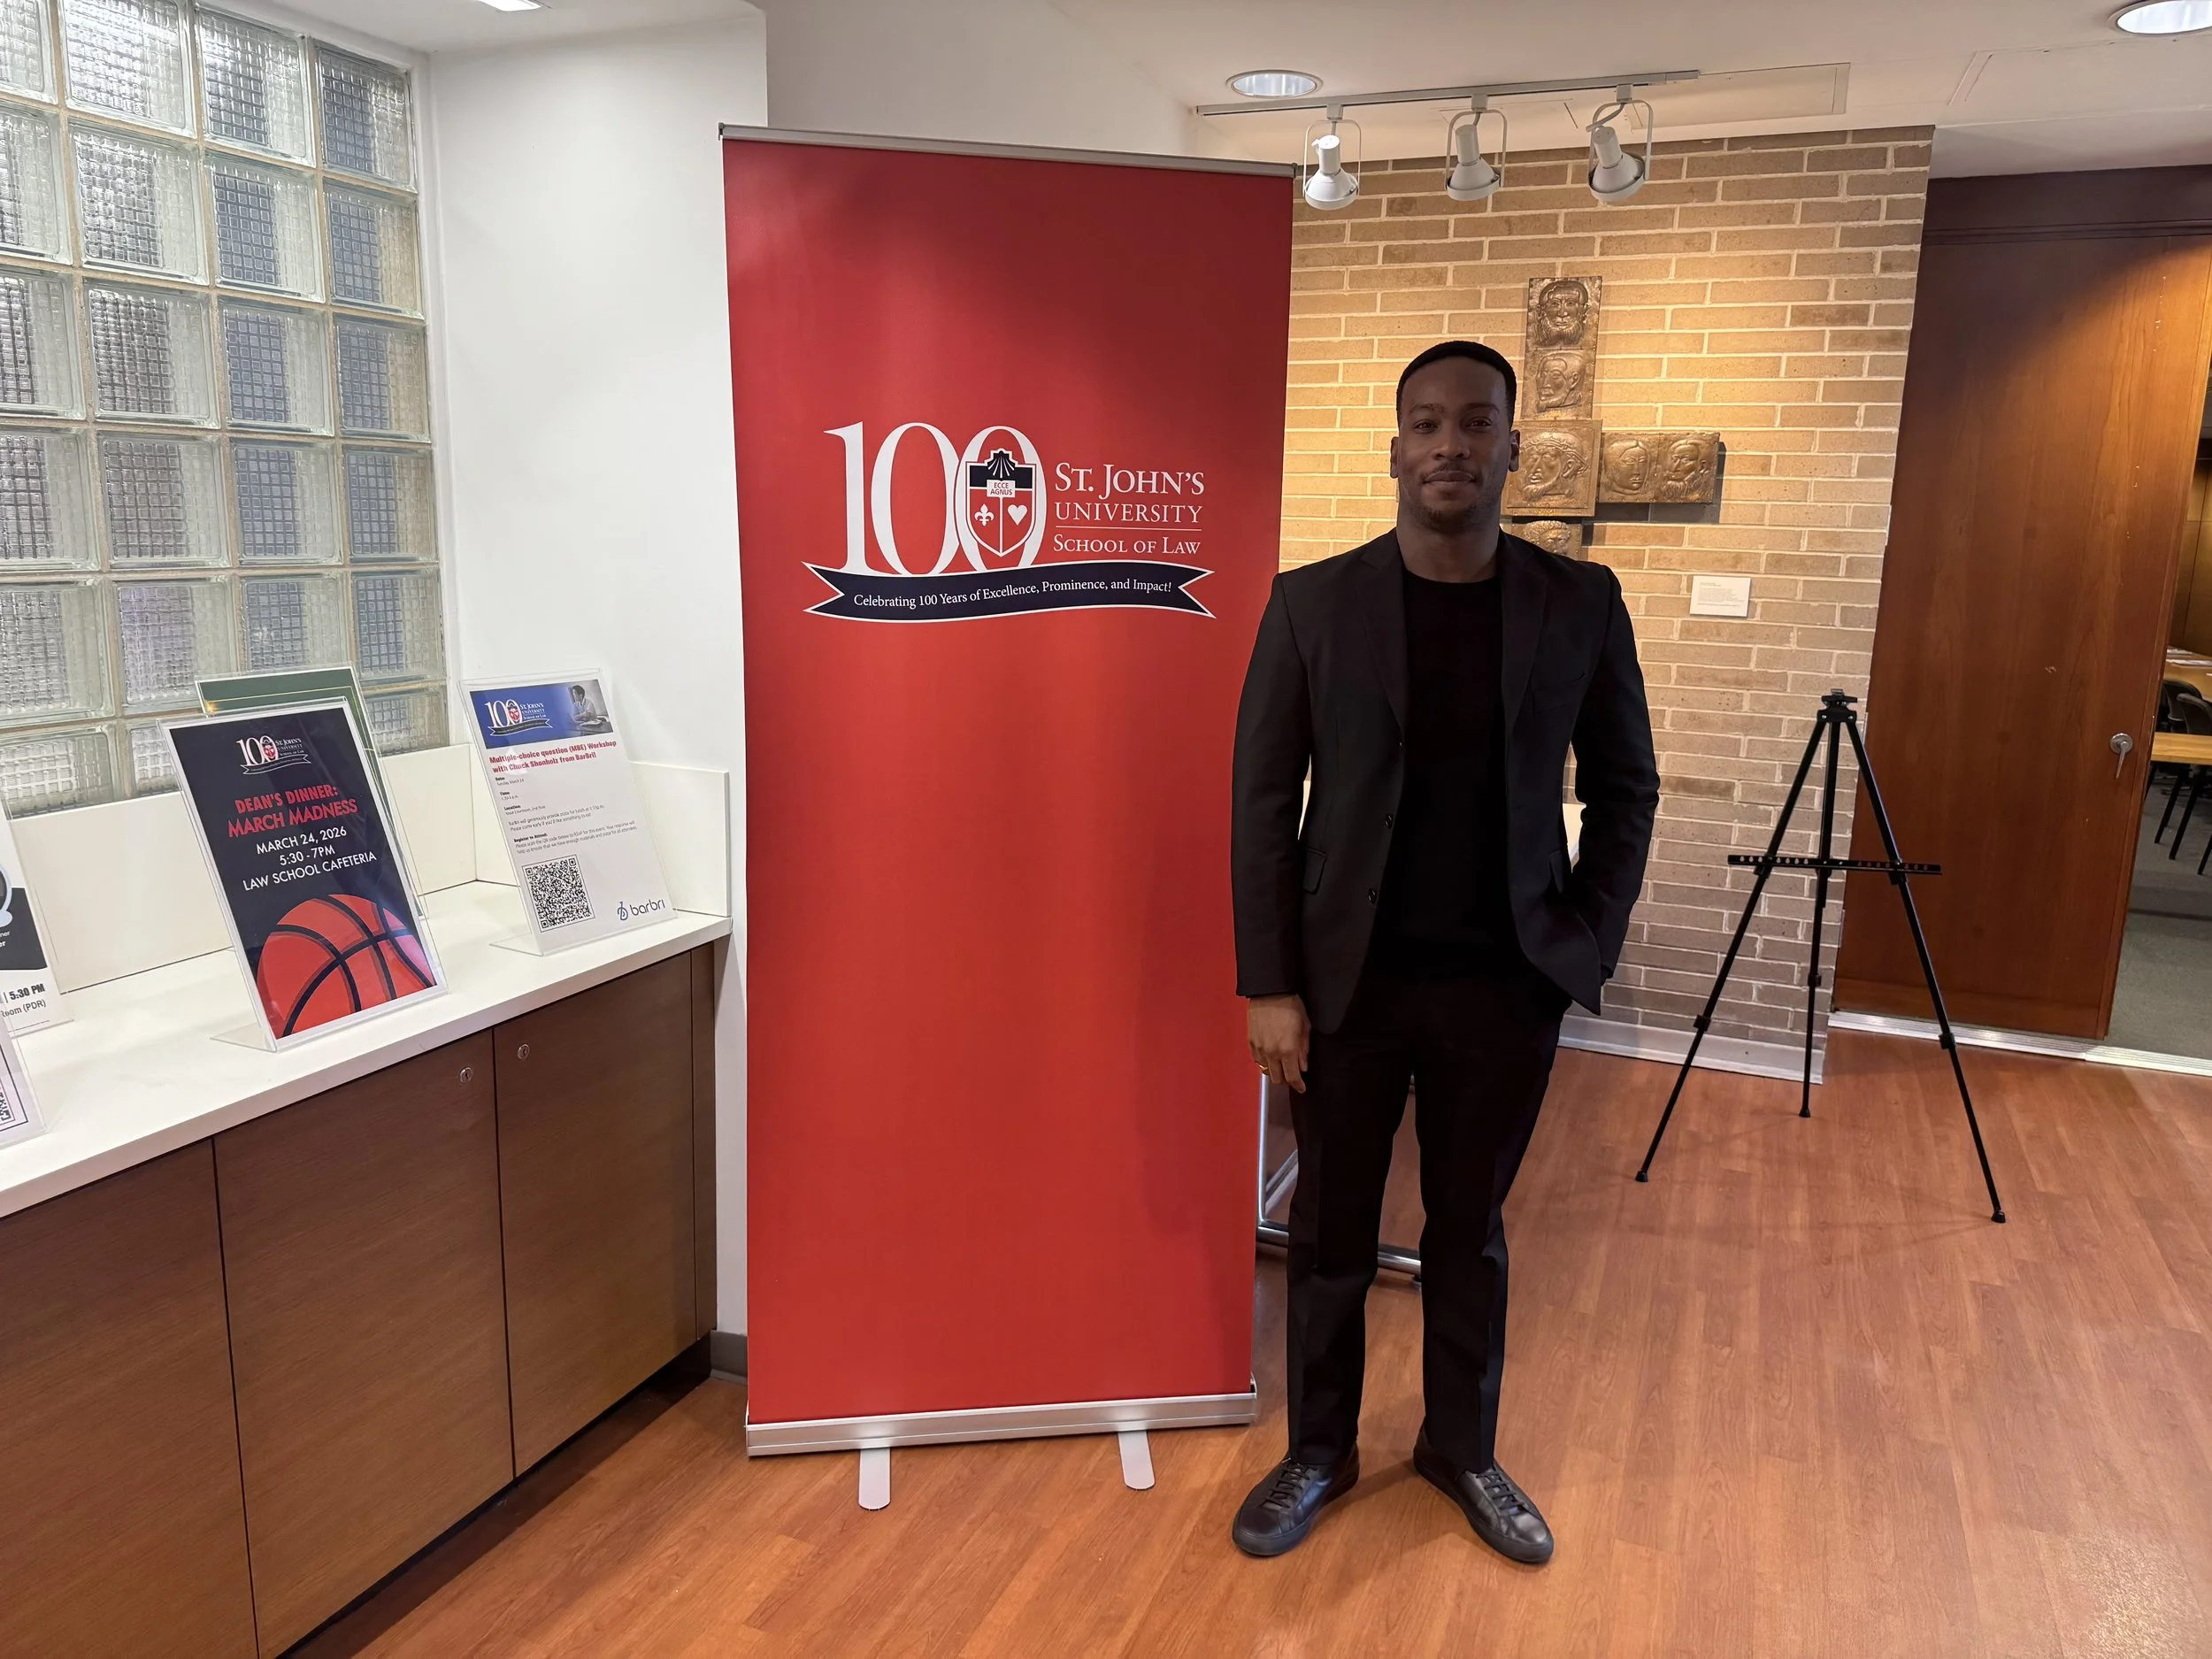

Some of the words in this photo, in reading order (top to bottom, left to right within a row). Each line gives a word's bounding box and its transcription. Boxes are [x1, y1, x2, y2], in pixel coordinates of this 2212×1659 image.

[823, 421, 1047, 576] 100
[1055, 502, 1203, 523] UNIVERSITY
[853, 594, 917, 610] Celebrating
[919, 595, 938, 606] 100
[940, 593, 968, 604] Years
[971, 588, 982, 601] of
[983, 583, 1040, 600] Excellence,
[1042, 580, 1109, 593] Prominence,
[1110, 579, 1130, 590] and
[1133, 579, 1171, 594] Impact!
[484, 699, 522, 727] 100
[236, 735, 279, 766] 100
[541, 748, 568, 757] question
[569, 744, 587, 753] (MBE)
[588, 741, 617, 749] Workshop
[493, 764, 508, 773] with
[509, 762, 529, 771] Chuck
[234, 792, 283, 814] DEAN'S
[285, 784, 339, 804] DINNER:
[228, 812, 285, 838] MARCH
[289, 798, 358, 826] MADNESS
[256, 835, 298, 855] MARCH
[300, 833, 319, 845] 24,
[319, 826, 347, 841] 2026
[280, 851, 303, 865] 5:30
[311, 845, 335, 858] 7PM
[242, 874, 269, 891] LAW
[273, 864, 320, 884] SCHOOL
[322, 851, 377, 872] CAFETERIA
[629, 899, 665, 916] barbri
[9, 987, 30, 1000] 5:30
[31, 983, 45, 995] PM
[23, 999, 46, 1013] (PDR)
